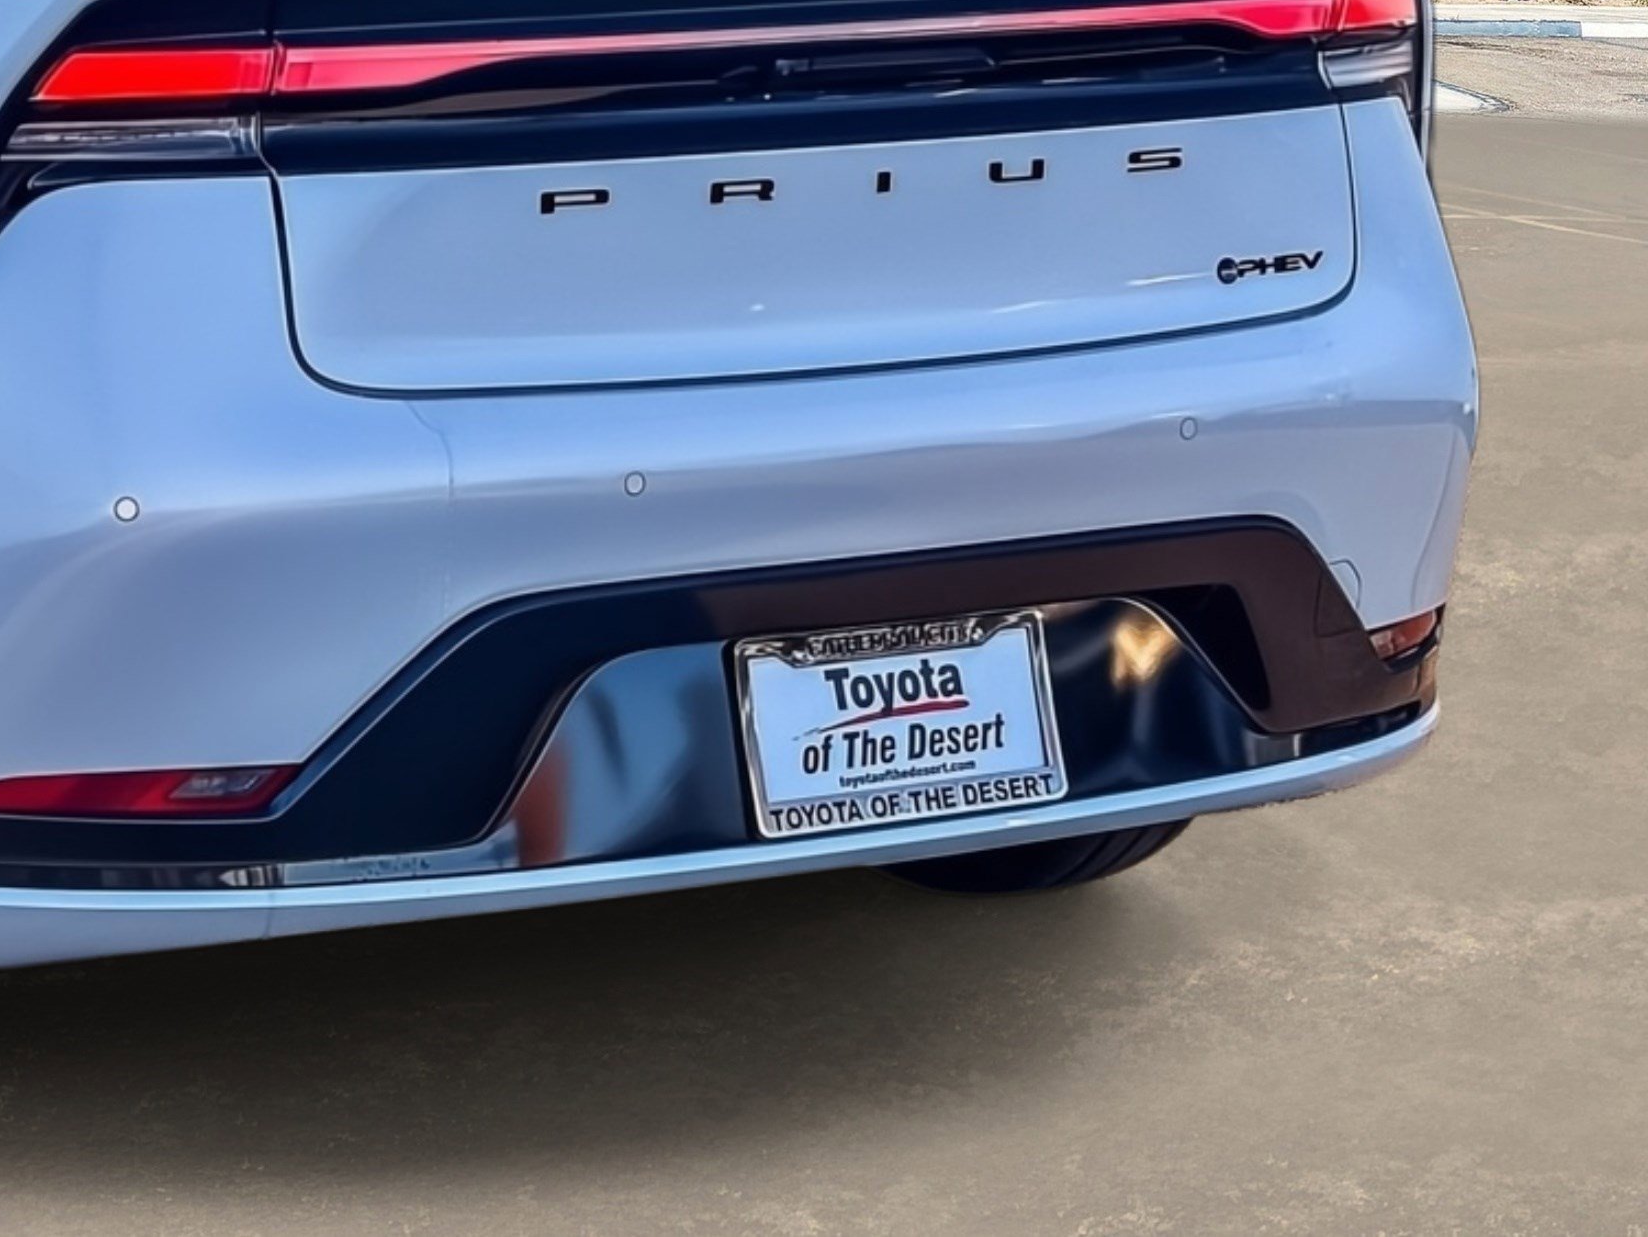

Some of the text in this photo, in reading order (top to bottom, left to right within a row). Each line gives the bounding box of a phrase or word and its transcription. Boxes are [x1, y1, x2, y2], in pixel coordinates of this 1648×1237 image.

[540, 147, 1184, 215] PRIUS
[1236, 250, 1324, 278] PHEV
[824, 659, 964, 713] Toyota
[803, 713, 1005, 774] of The Desert
[839, 759, 977, 789] toyotaofthedesert.com
[770, 773, 1053, 832] TOYOTA OF THE DESERT
